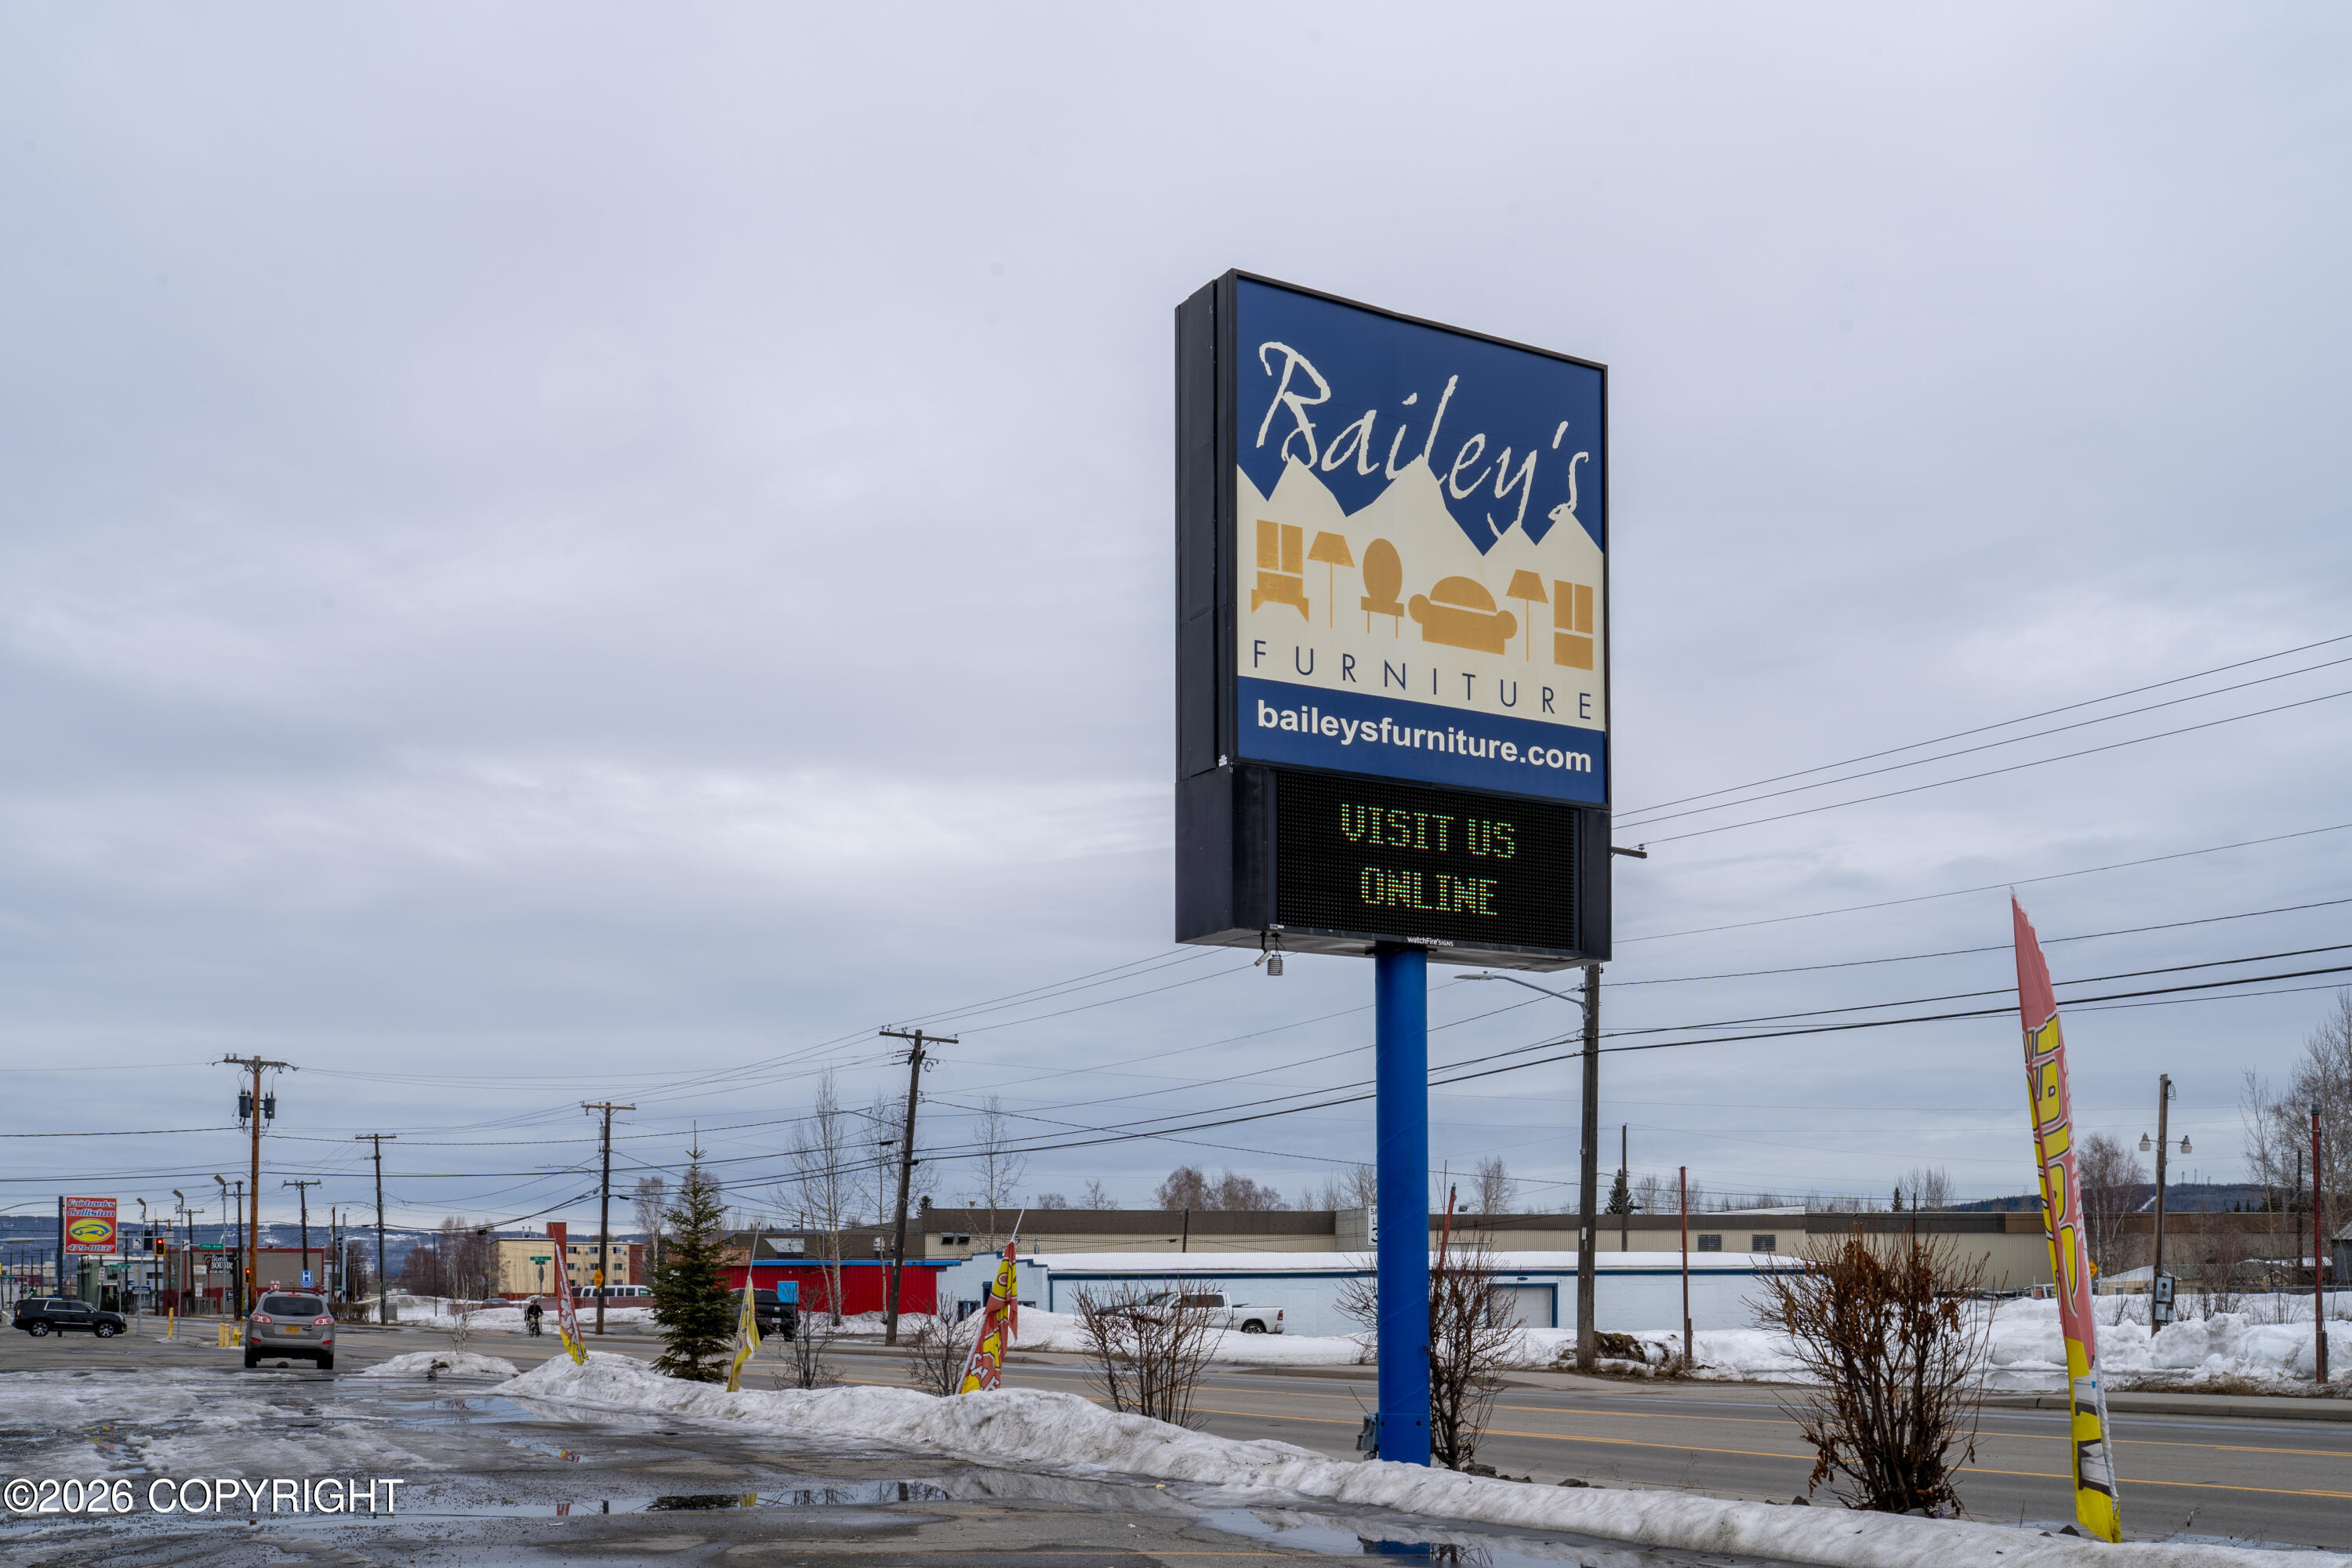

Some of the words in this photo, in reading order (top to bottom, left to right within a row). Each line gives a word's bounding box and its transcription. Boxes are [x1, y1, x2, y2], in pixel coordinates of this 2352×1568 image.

[1255, 340, 1591, 539] Bailey's
[1254, 639, 1592, 720] FURNITURE
[1257, 699, 1592, 774] baileysfurniture.com
[1341, 803, 1454, 852] VISIT
[1468, 818, 1515, 858] US
[1360, 866, 1498, 916] ONLINE
[67, 1199, 115, 1207] Fairbanks
[67, 1208, 115, 1217] Collision
[67, 1243, 114, 1252] 479-0837
